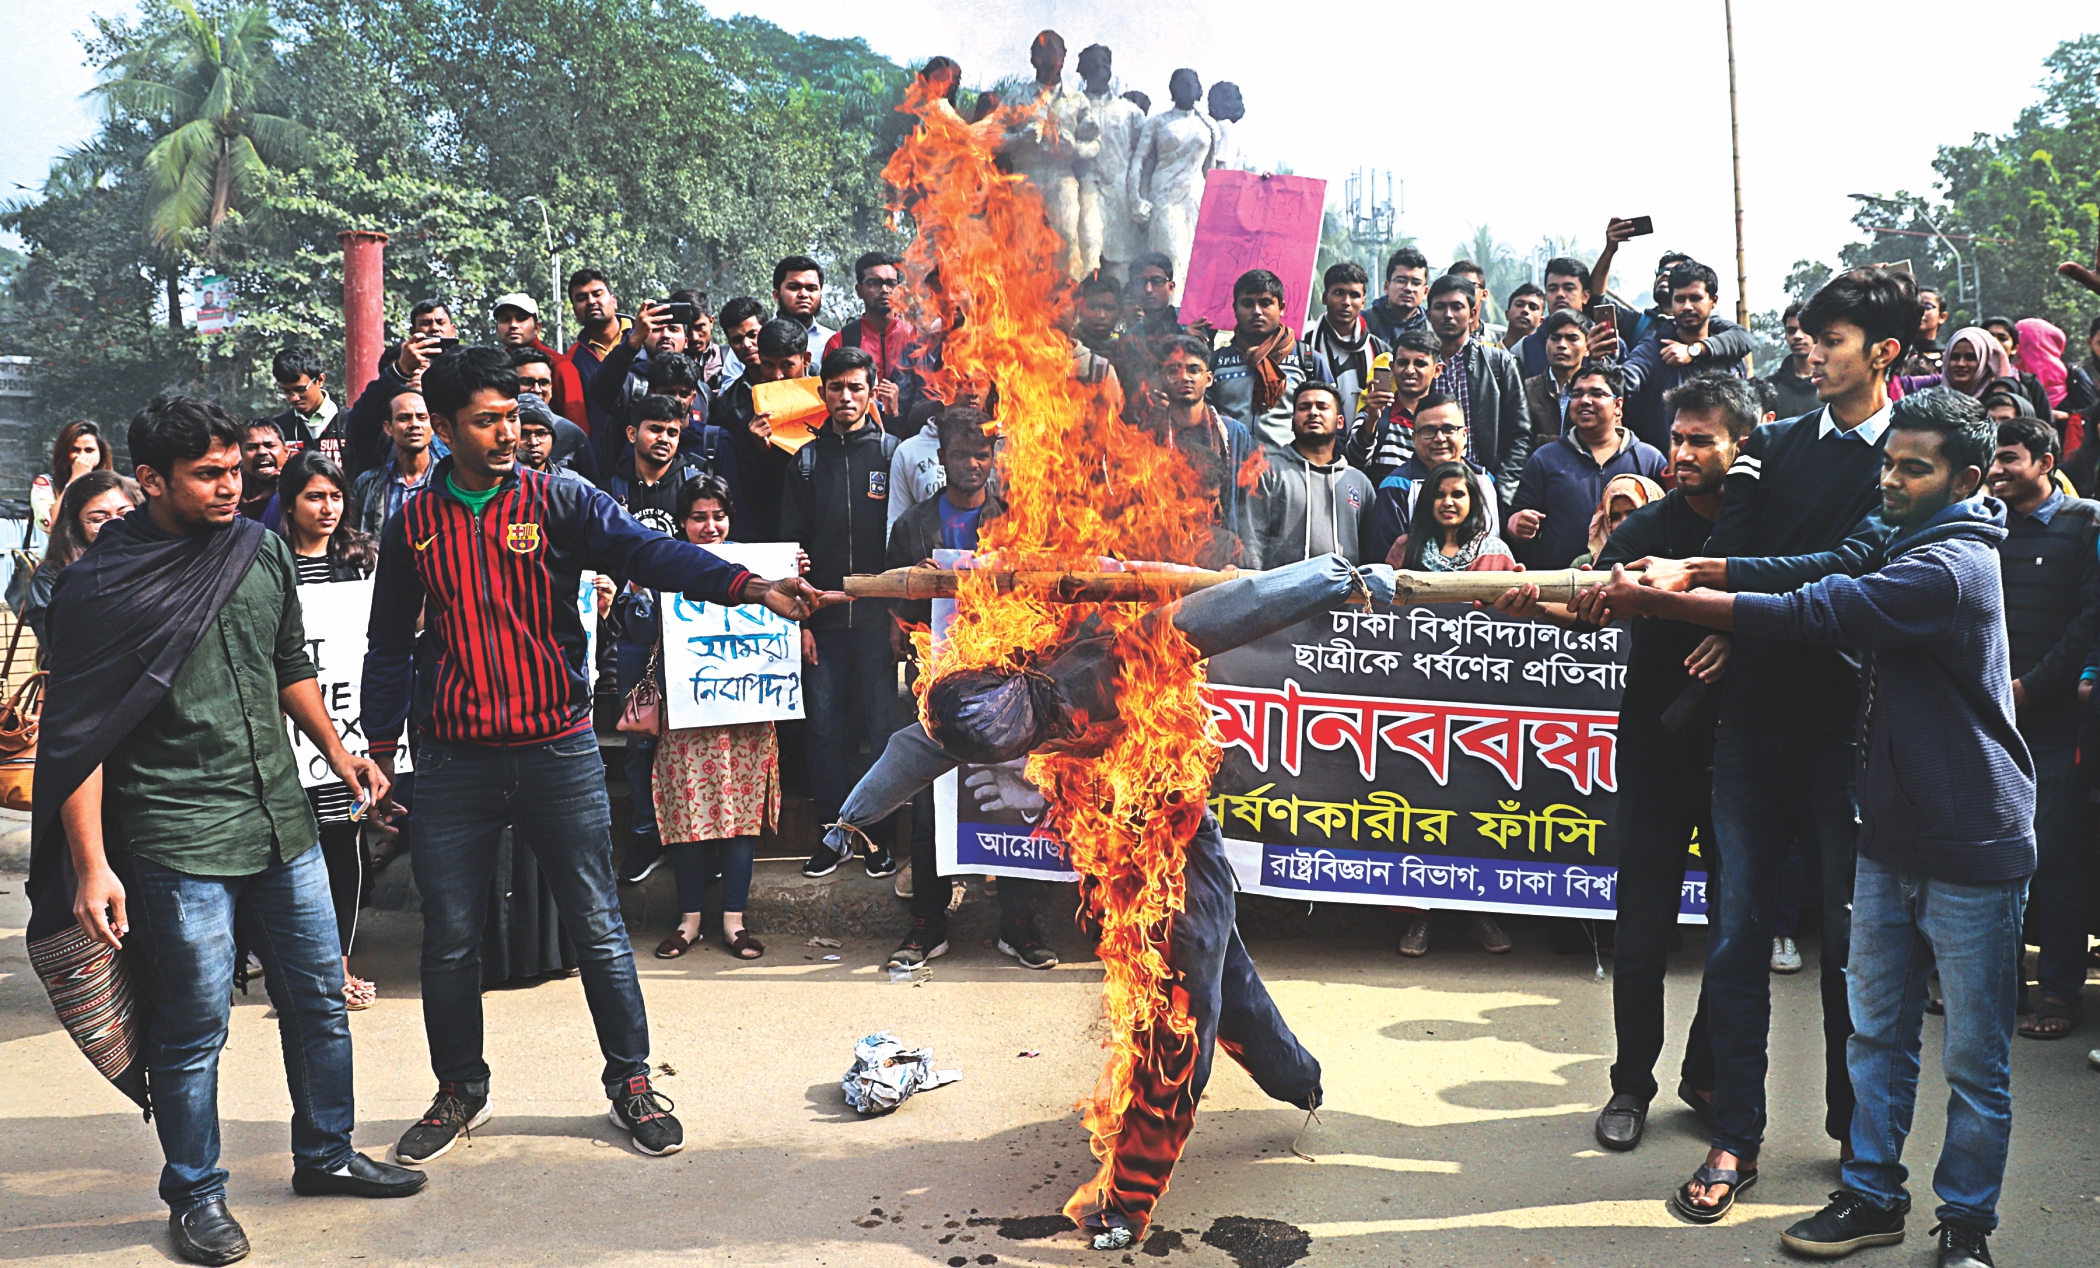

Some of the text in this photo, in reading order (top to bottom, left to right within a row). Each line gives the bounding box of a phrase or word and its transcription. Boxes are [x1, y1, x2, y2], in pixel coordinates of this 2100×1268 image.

[1329, 607, 1623, 652] ঢাকা বিশ্ববিদ্যালয়ের
[1292, 638, 1402, 676] ছাত্রীকে
[1412, 646, 1514, 683] ধর্ষণের
[1204, 678, 1620, 795] মানববন্ধ
[976, 831, 1066, 860] আয়োজ
[1470, 799, 1607, 856] ফাঁসি
[1268, 848, 1394, 885] রাষ্ট্রবিজ্ঞান
[1399, 855, 1486, 897] বিভাগ,
[1495, 868, 1557, 896] ঢাকা
